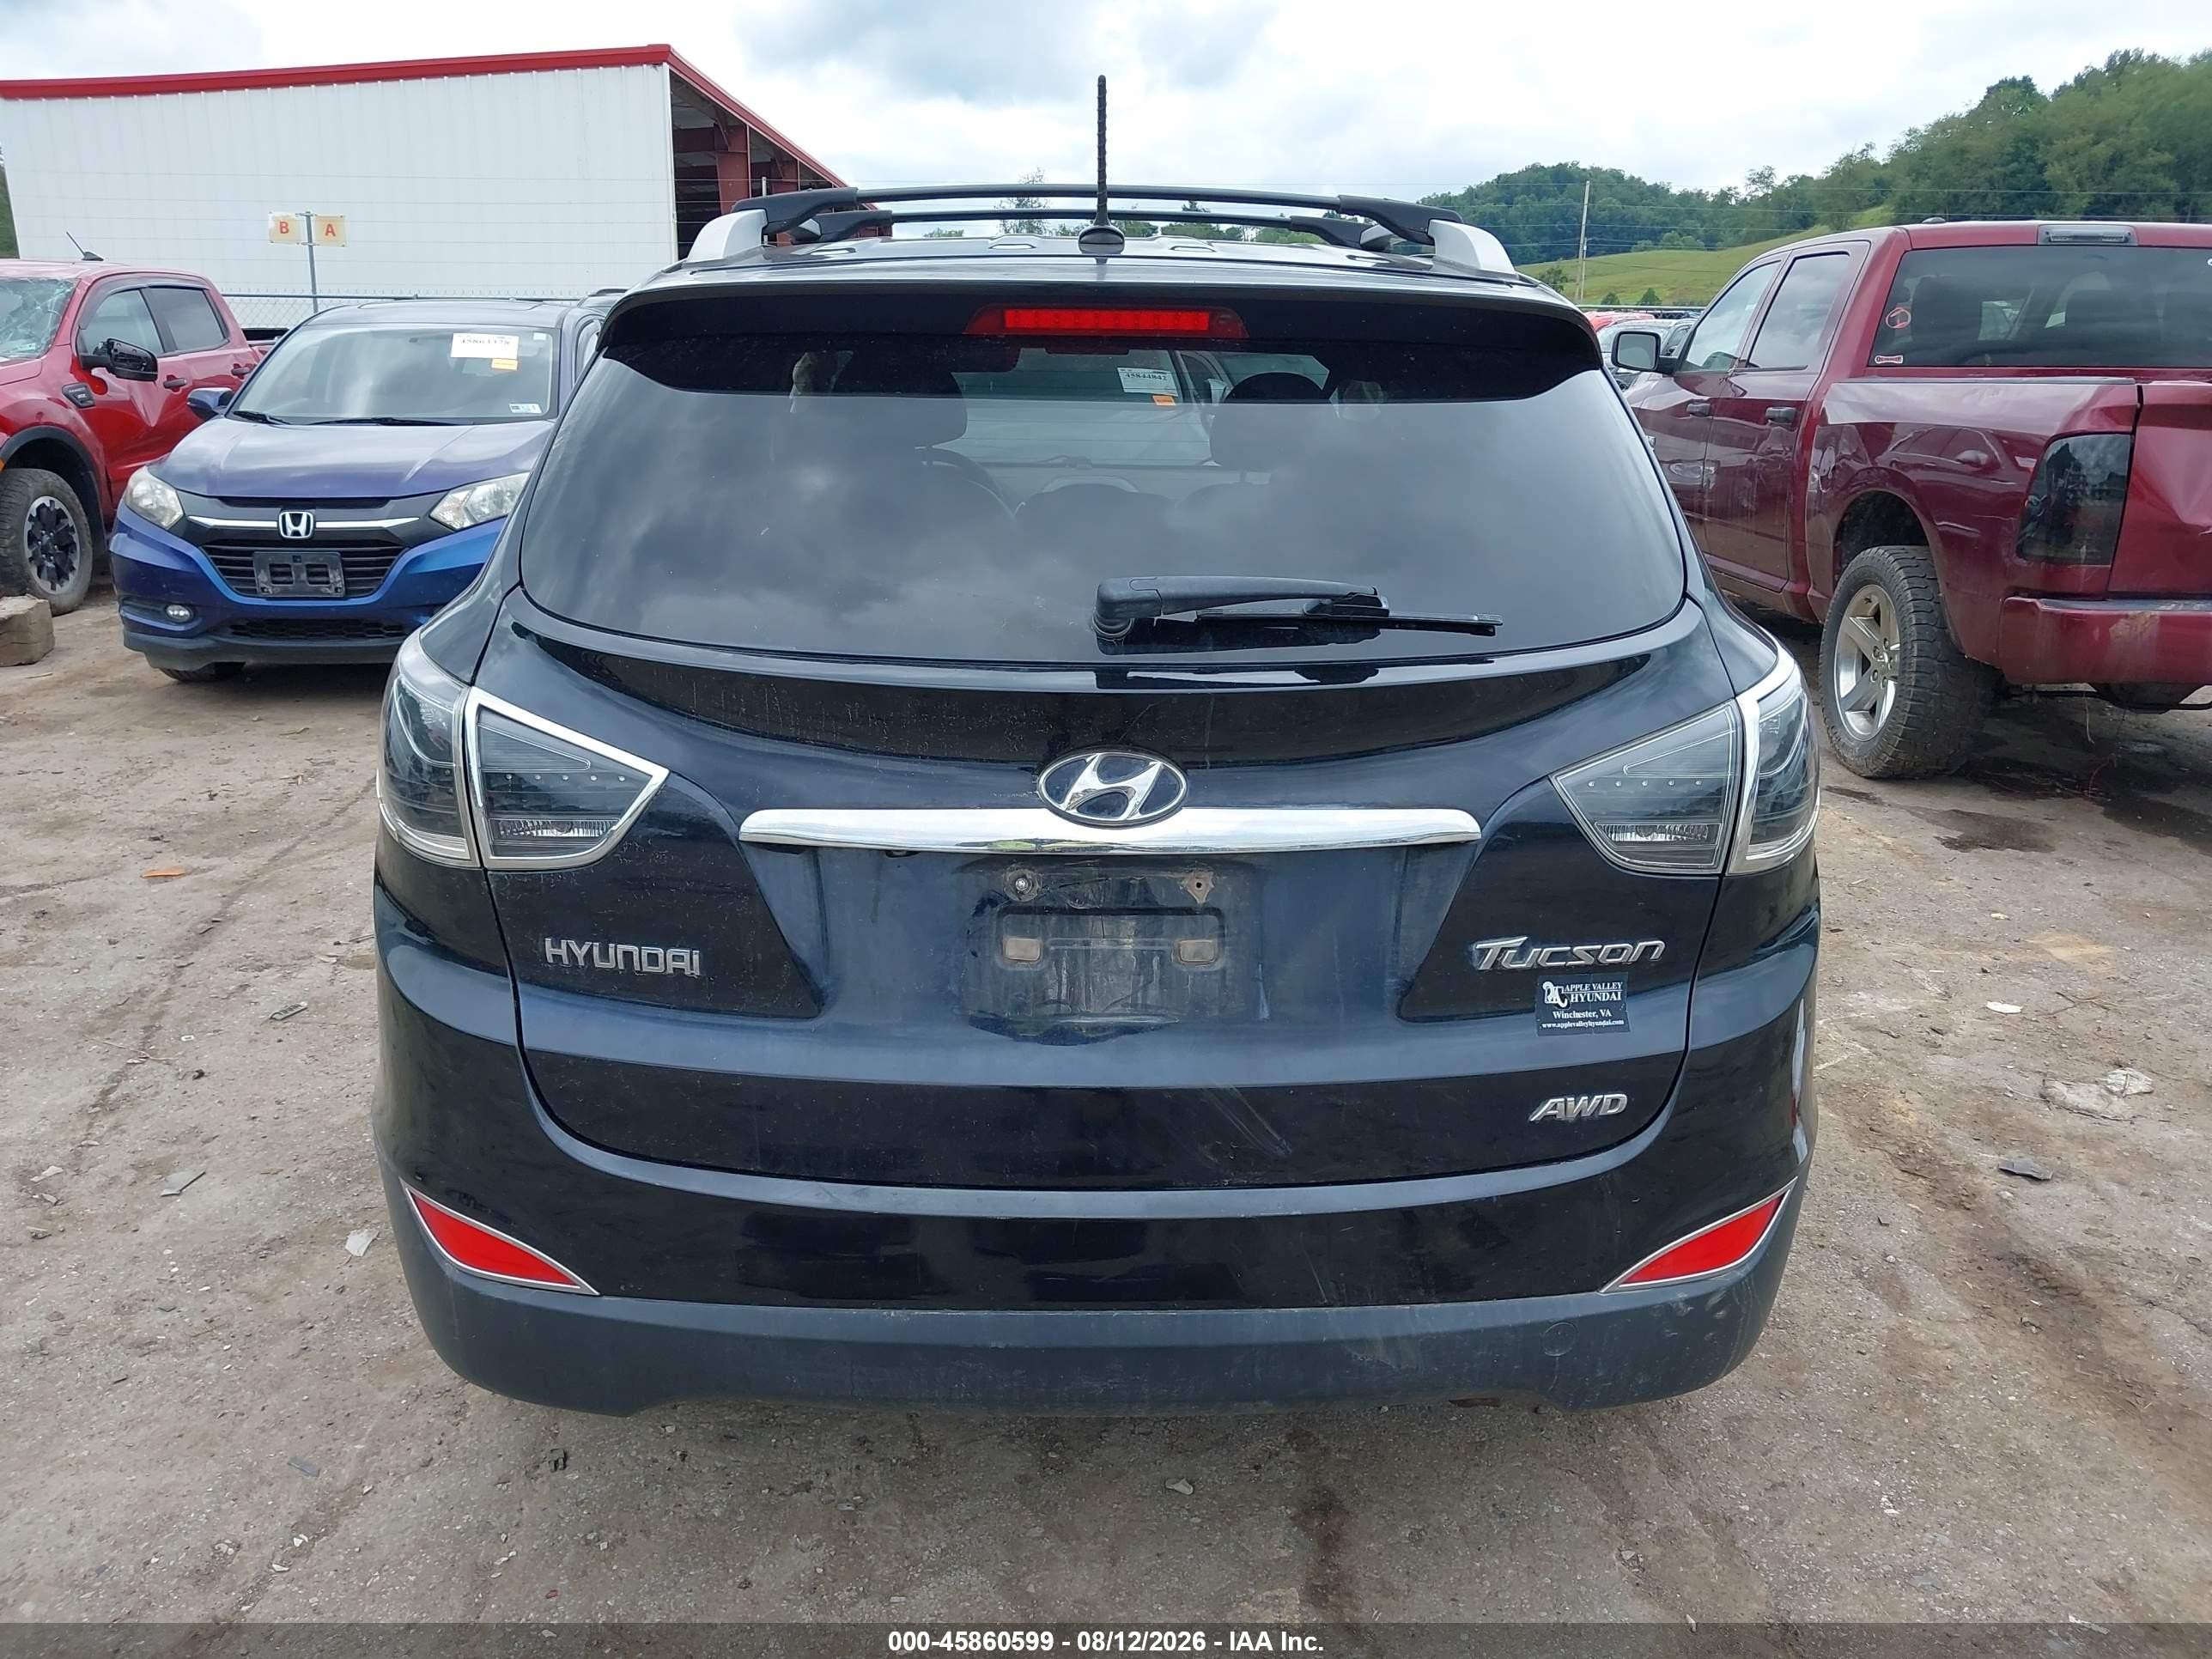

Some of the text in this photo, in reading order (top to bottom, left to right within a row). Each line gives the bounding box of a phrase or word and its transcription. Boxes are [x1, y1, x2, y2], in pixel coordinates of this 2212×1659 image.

[279, 222, 289, 234] B
[325, 224, 336, 237] A
[544, 938, 701, 976] HYUNDAI
[1565, 981, 1623, 992] APPLE VALLEY
[1570, 991, 1622, 1003] HYUNDAI
[1553, 1009, 1612, 1019] Winchester, VA
[1541, 1019, 1625, 1029] www.applevalleyhyundai.com
[1528, 1093, 1628, 1121] AWD
